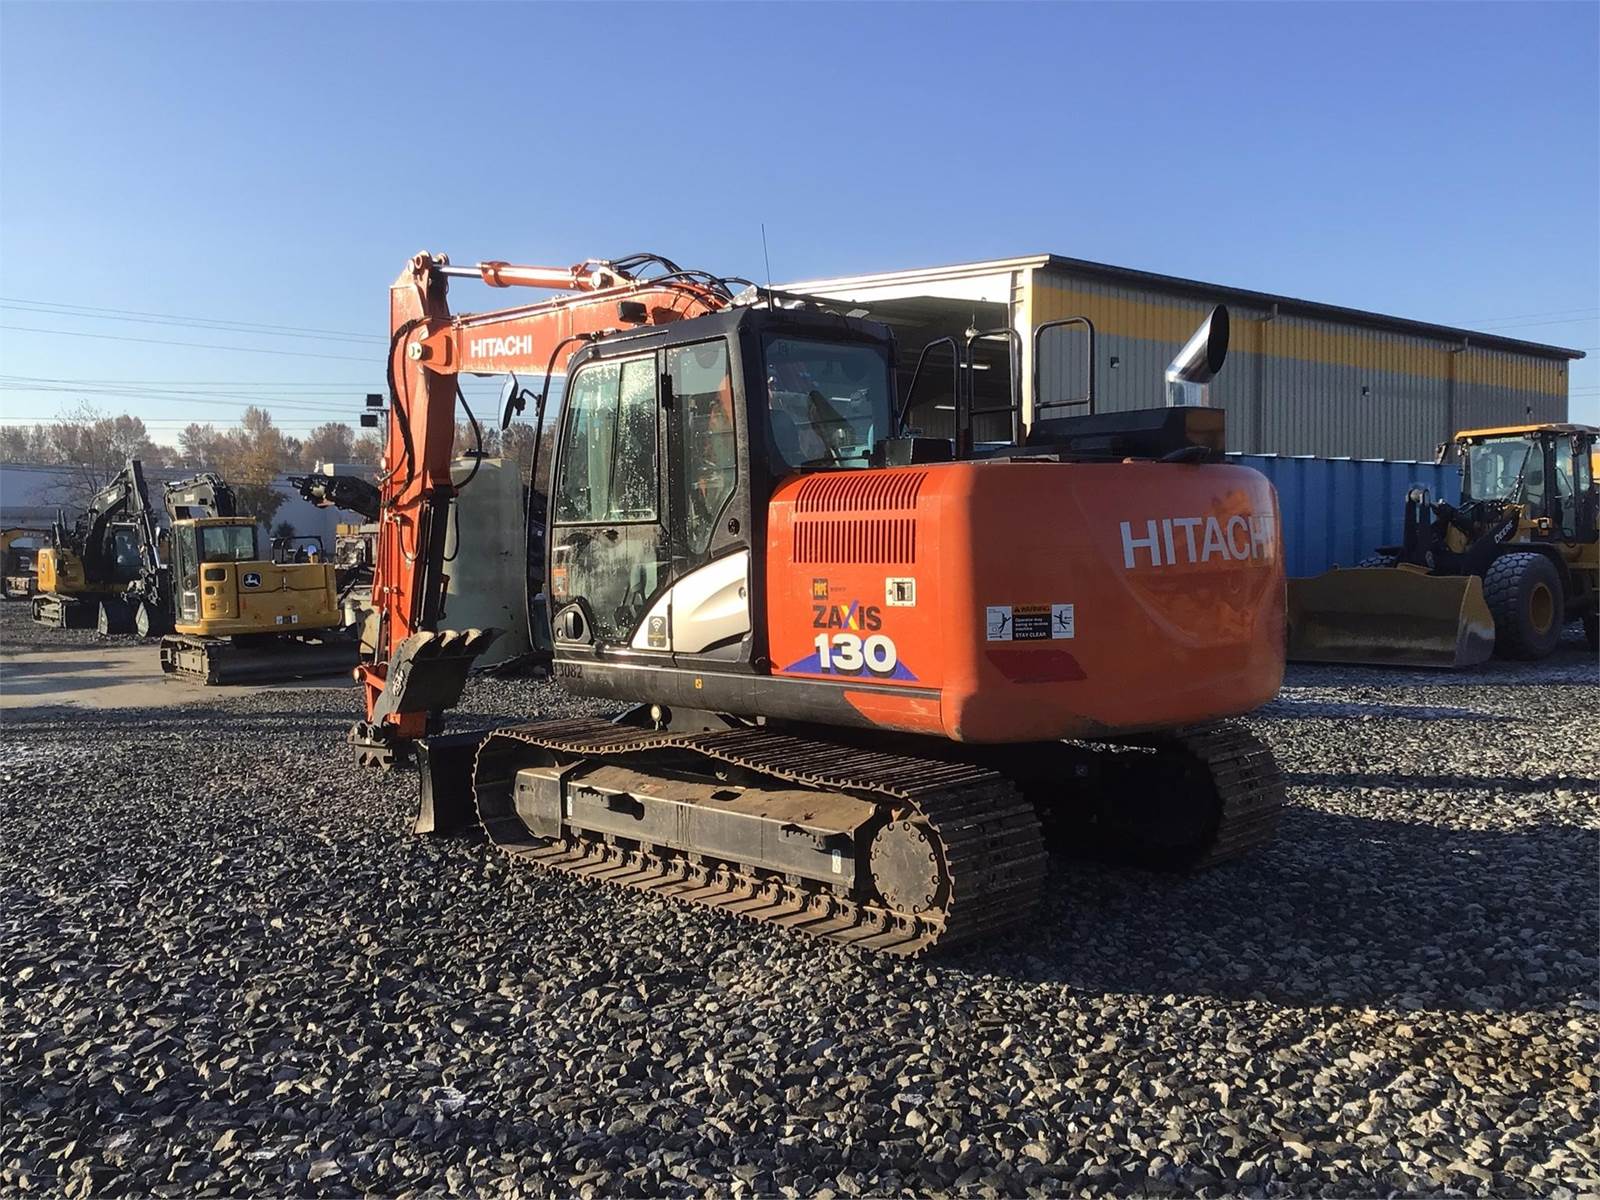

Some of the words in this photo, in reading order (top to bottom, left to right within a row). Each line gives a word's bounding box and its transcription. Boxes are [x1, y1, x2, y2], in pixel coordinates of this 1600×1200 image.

[470, 335, 532, 358] HITACHI
[812, 600, 882, 631] ZAXIS
[814, 633, 897, 678] 130
